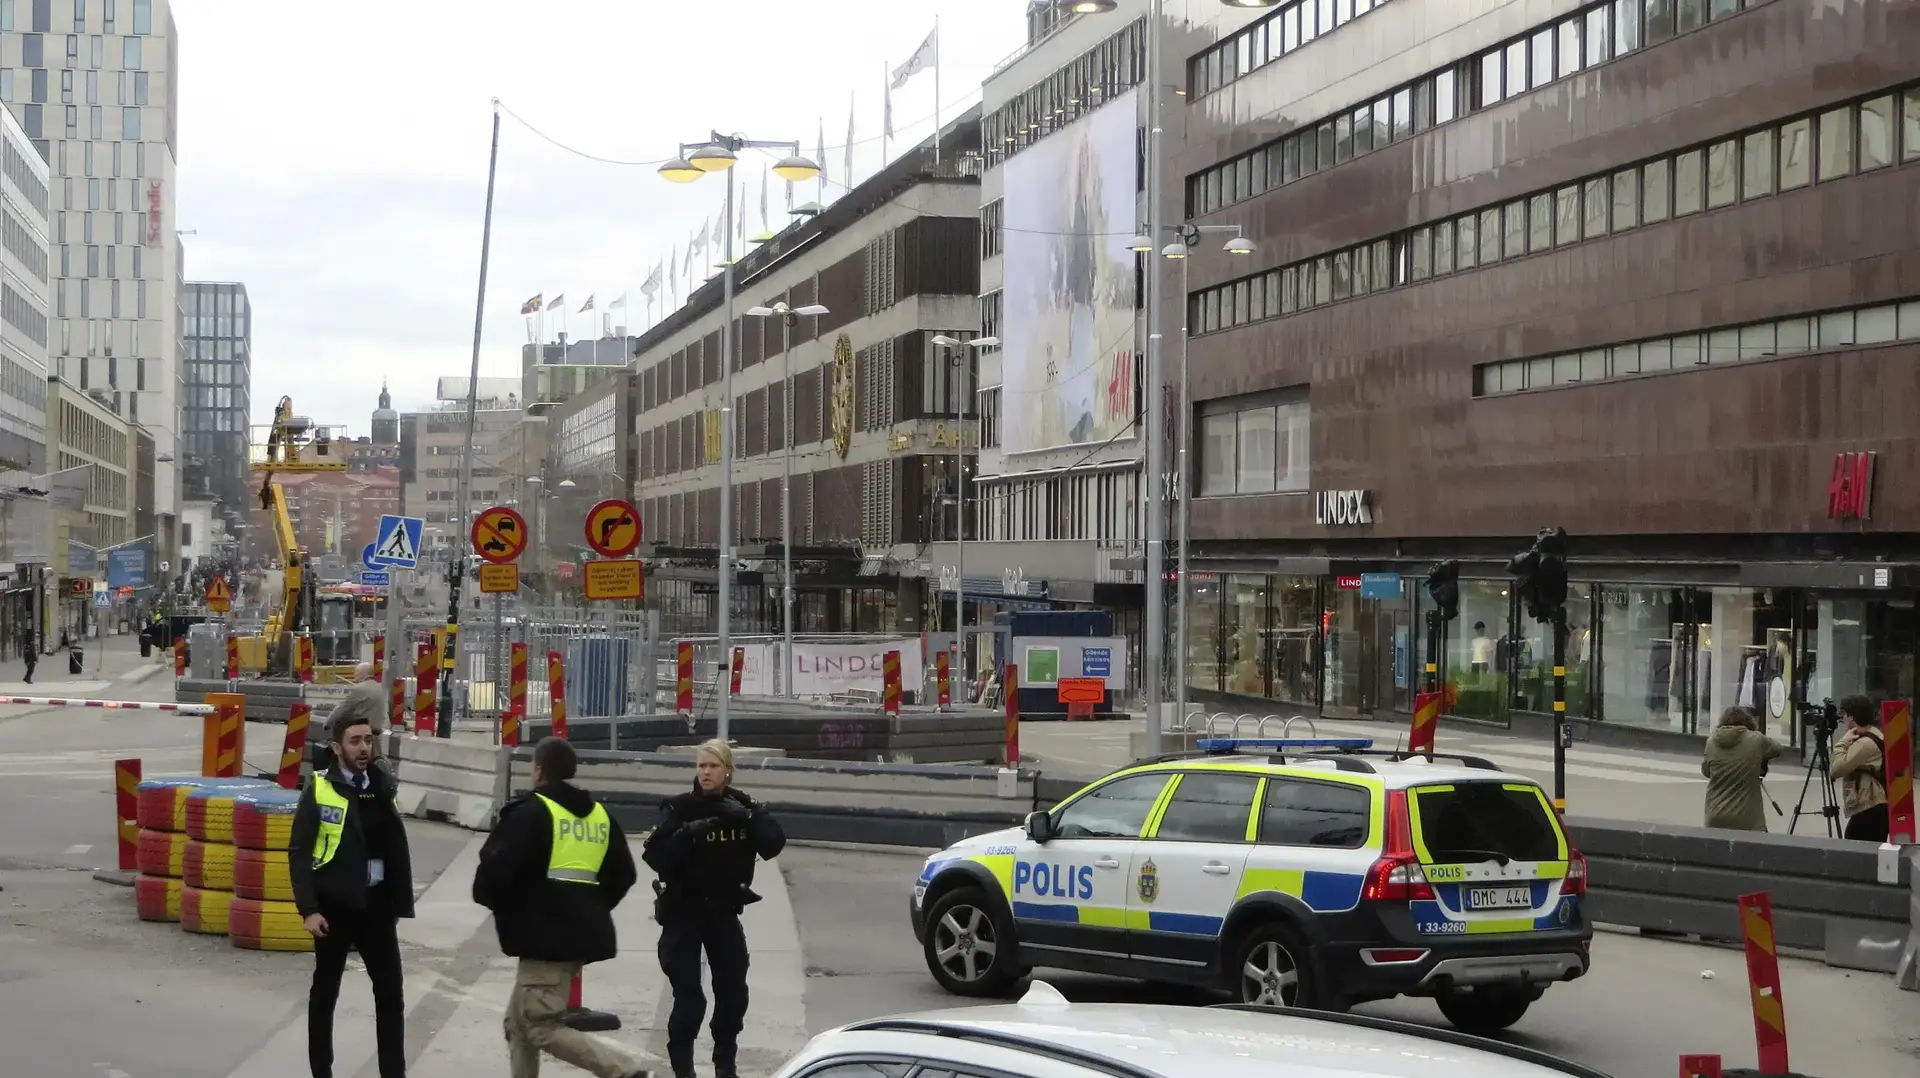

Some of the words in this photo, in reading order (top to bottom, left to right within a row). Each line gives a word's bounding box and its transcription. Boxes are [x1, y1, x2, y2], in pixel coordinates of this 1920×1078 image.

[1316, 490, 1366, 525] LINDEX
[798, 654, 881, 673] LINDE
[558, 818, 608, 845] POLIS
[706, 828, 747, 843] OLIS
[1015, 862, 1093, 899] POLIS
[1430, 867, 1461, 879] POLIS
[1465, 868, 1538, 877] VOLVO
[1472, 888, 1497, 907] DMC
[1506, 889, 1529, 905] 444
[1425, 921, 1466, 933] 33-9260
